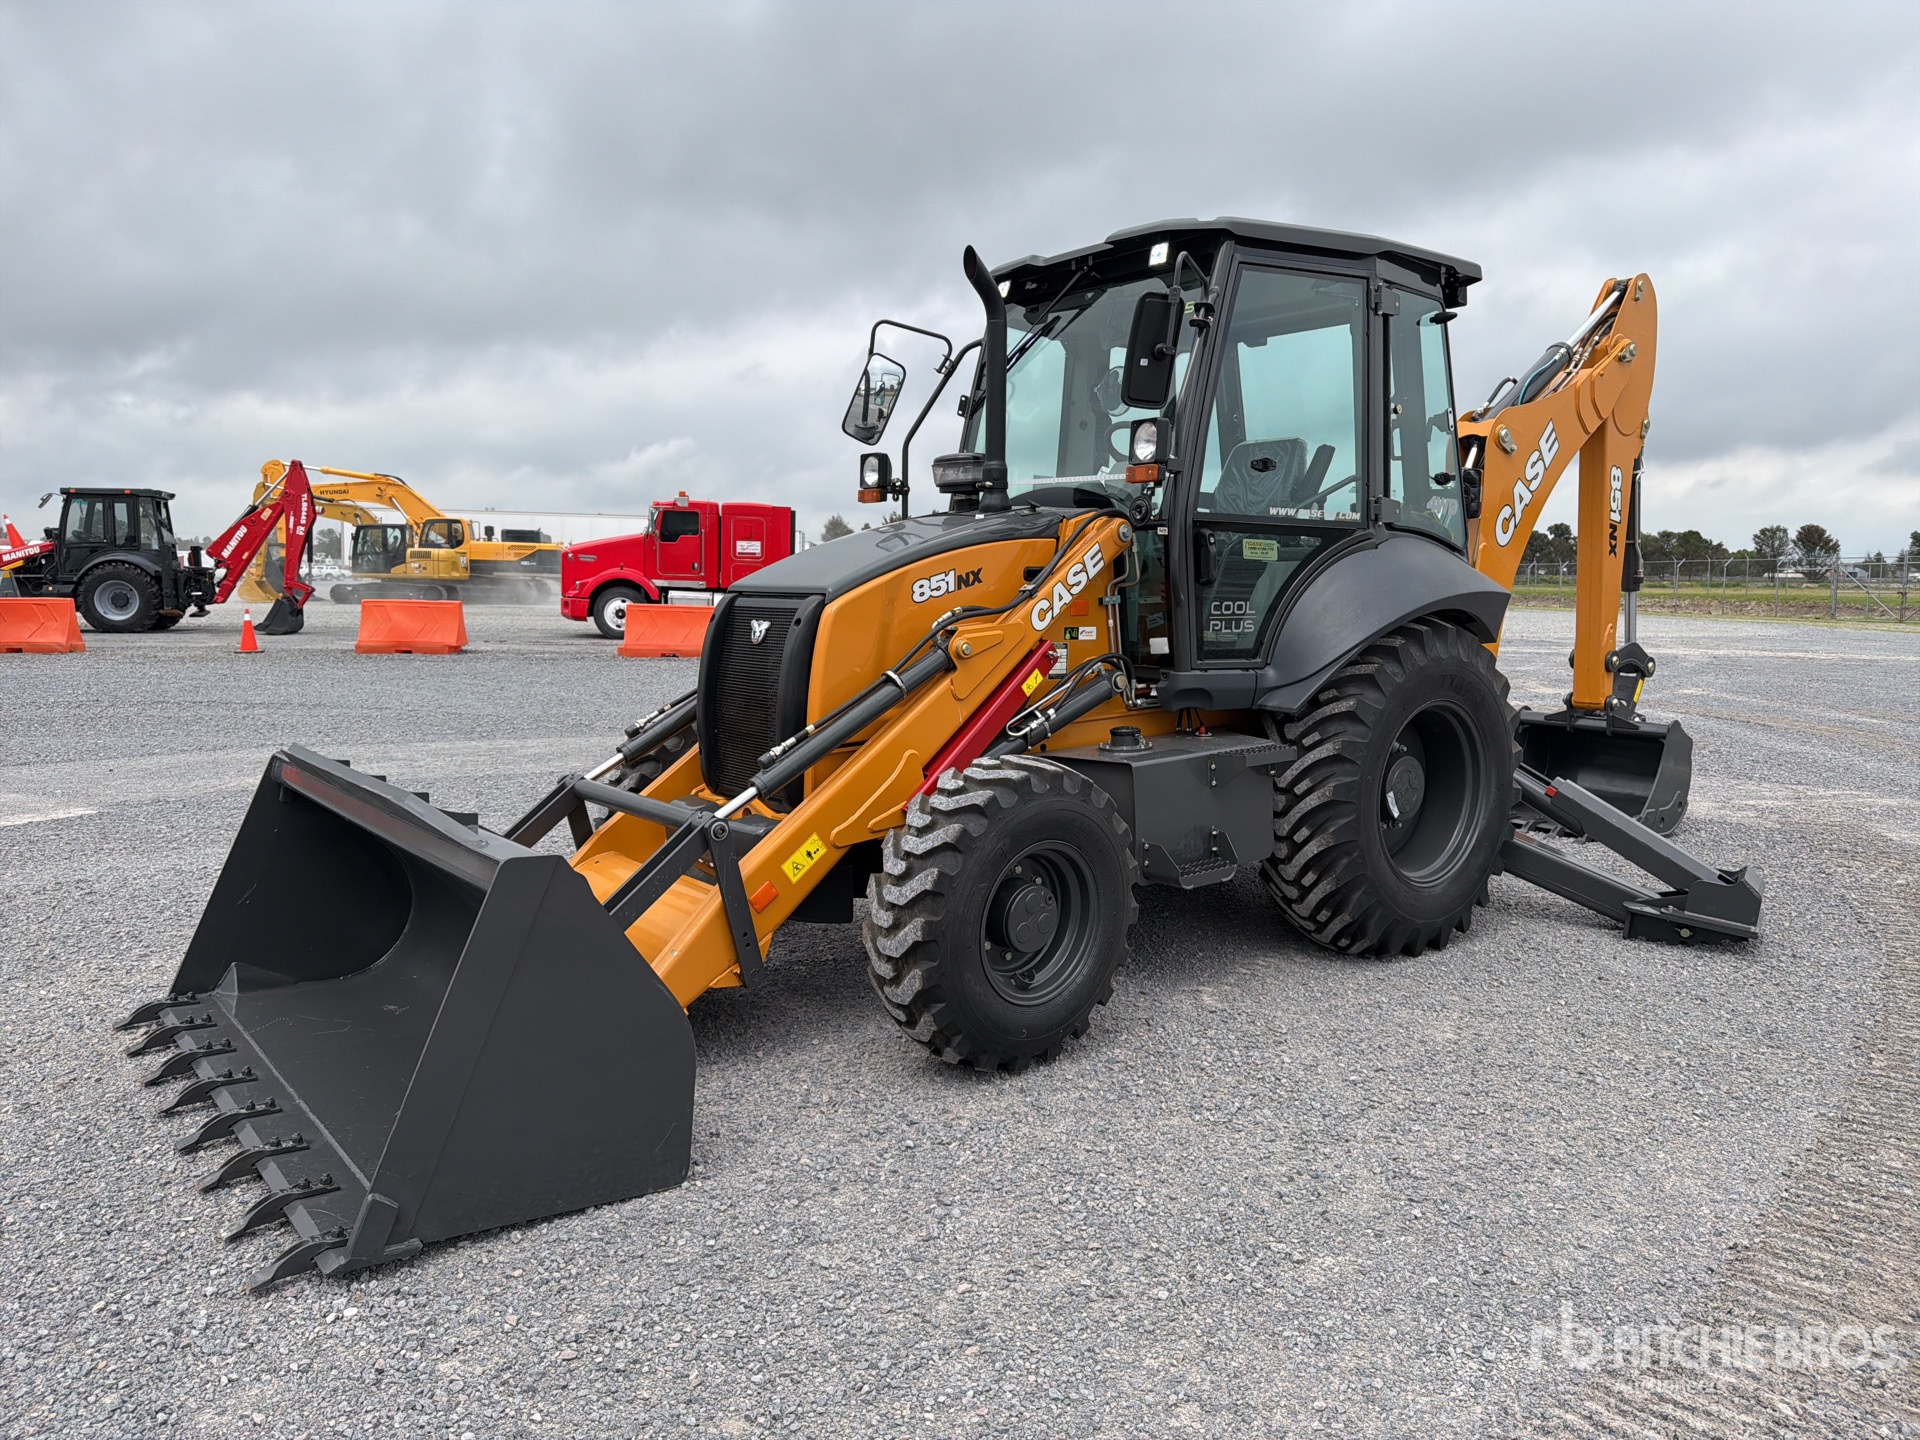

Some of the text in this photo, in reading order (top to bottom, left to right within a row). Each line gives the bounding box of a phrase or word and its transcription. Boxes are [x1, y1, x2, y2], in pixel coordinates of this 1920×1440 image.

[1495, 419, 1560, 547] CASE
[2, 545, 40, 562] MANITOU
[220, 524, 248, 559] MANITOU
[1030, 541, 1105, 631] CASE
[1210, 601, 1256, 615] COOL
[1209, 620, 1255, 633] PLUS
